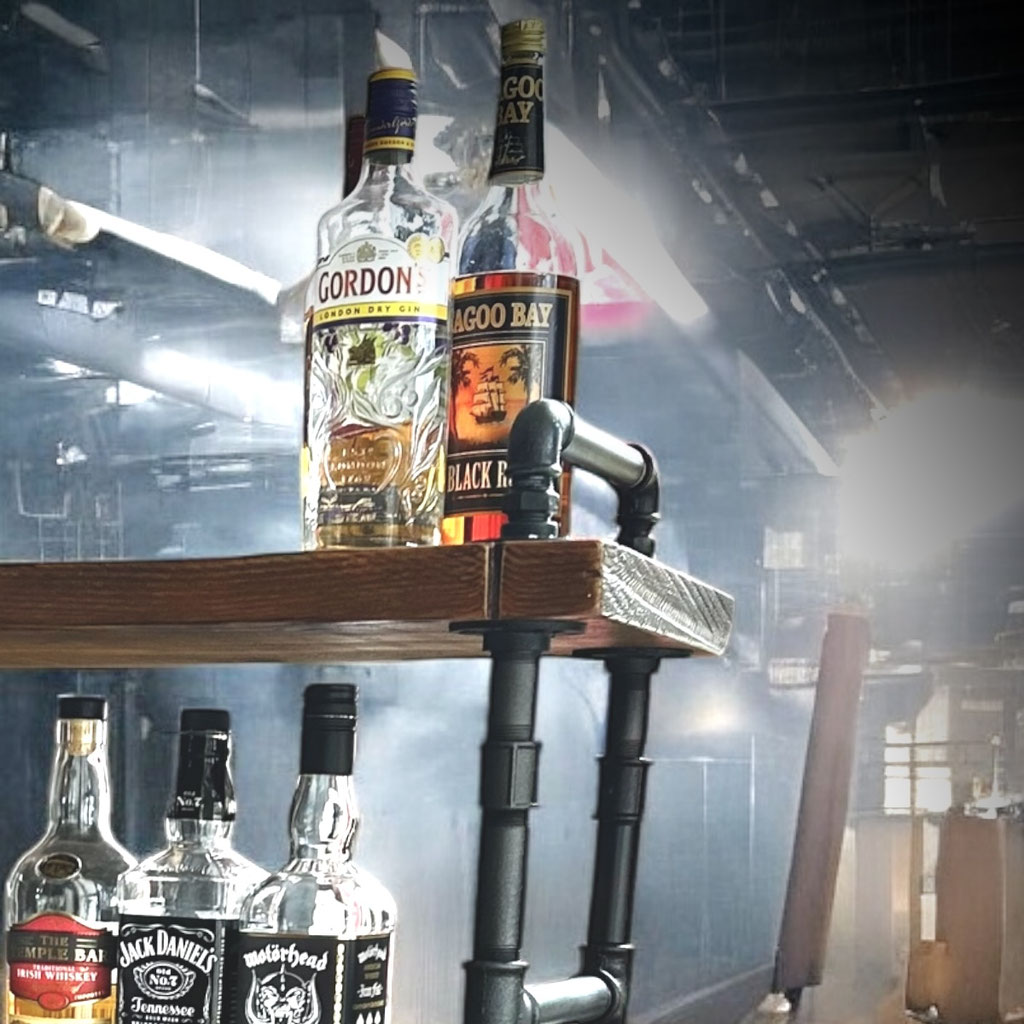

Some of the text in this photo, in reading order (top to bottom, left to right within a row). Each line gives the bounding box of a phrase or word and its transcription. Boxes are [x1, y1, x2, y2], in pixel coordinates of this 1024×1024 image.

[502, 75, 544, 102] GOO
[319, 305, 420, 320] LONDON DRY GIN
[510, 301, 553, 328] BAY
[447, 460, 493, 493] BLACK
[39, 935, 69, 947] THE
[119, 929, 218, 974] JACK DANIEL'S
[17, 968, 98, 982] IRISH WHISKEY
[130, 996, 196, 1017] Tennessee
